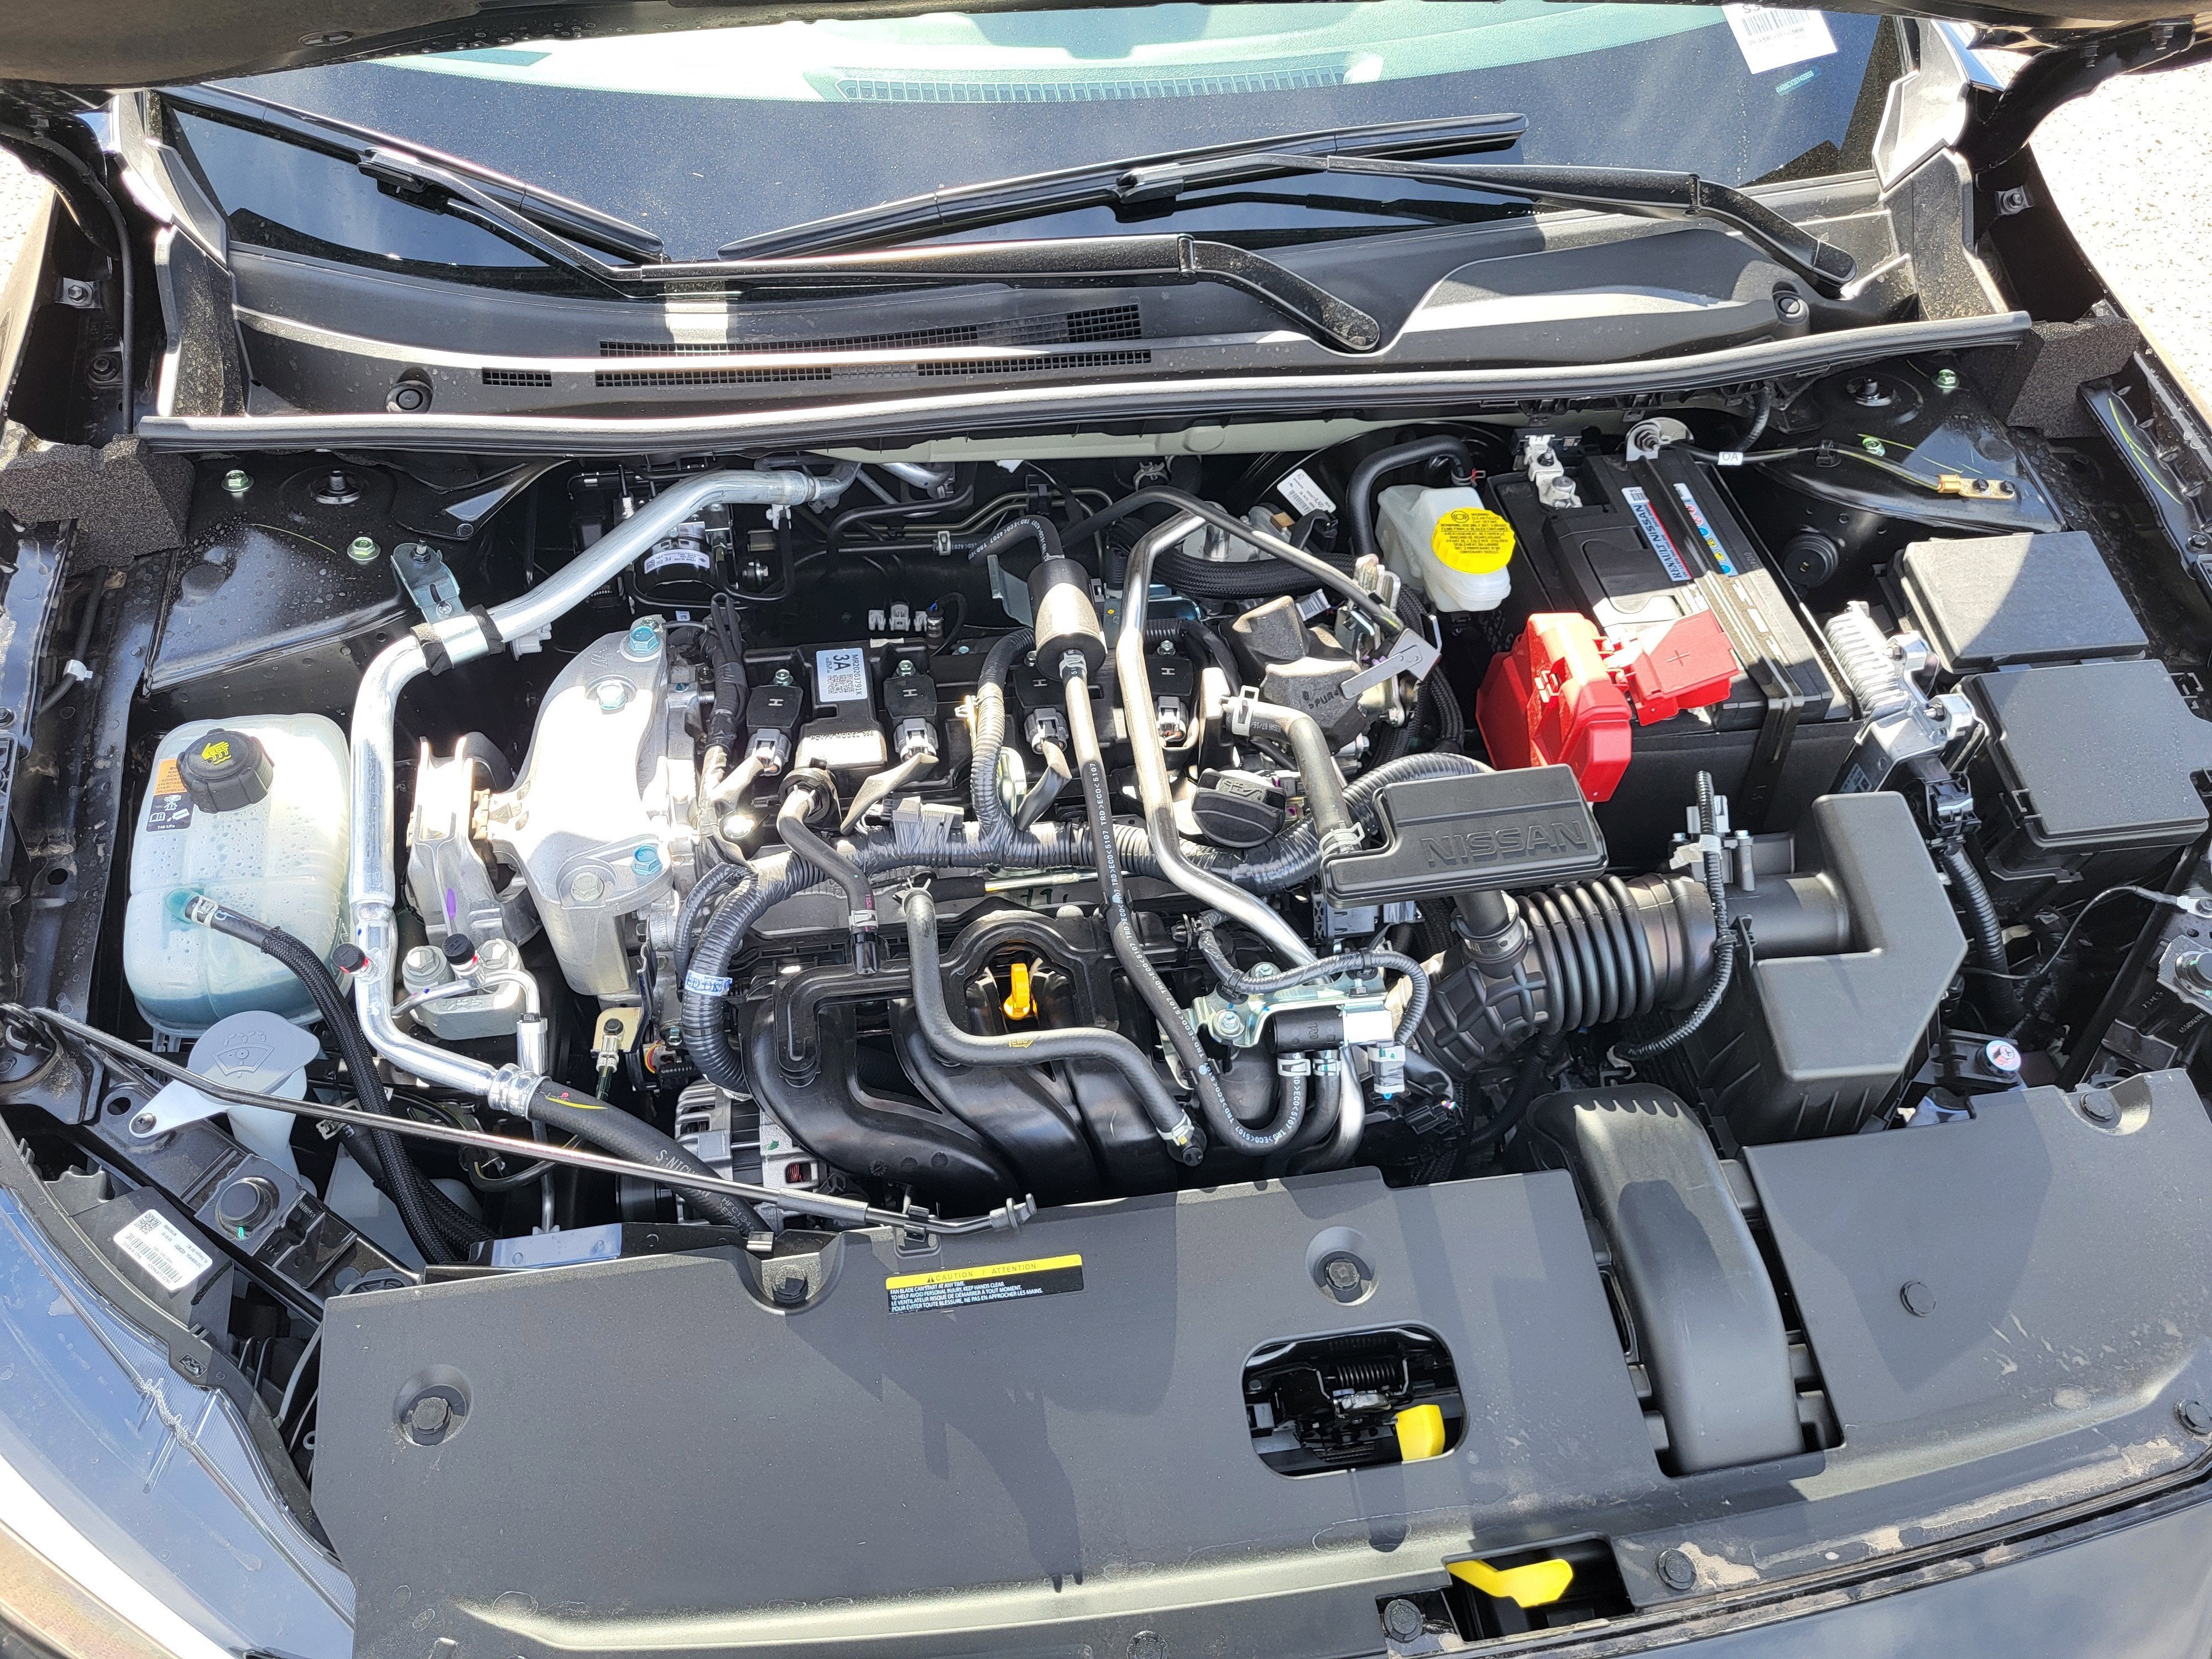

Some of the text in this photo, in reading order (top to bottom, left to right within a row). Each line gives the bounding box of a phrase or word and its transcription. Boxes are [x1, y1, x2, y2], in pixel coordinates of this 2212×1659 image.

[1634, 504, 1661, 542] NISSAN
[1656, 543, 1682, 578] RENAULT
[833, 654, 851, 671] 3A
[852, 654, 863, 696] MR20203791K
[1421, 821, 1587, 865] NISSAN
[936, 1271, 973, 1281] CAUTION
[992, 1263, 1036, 1274] ATTENTION
[988, 1291, 1017, 1300] APPROCHER
